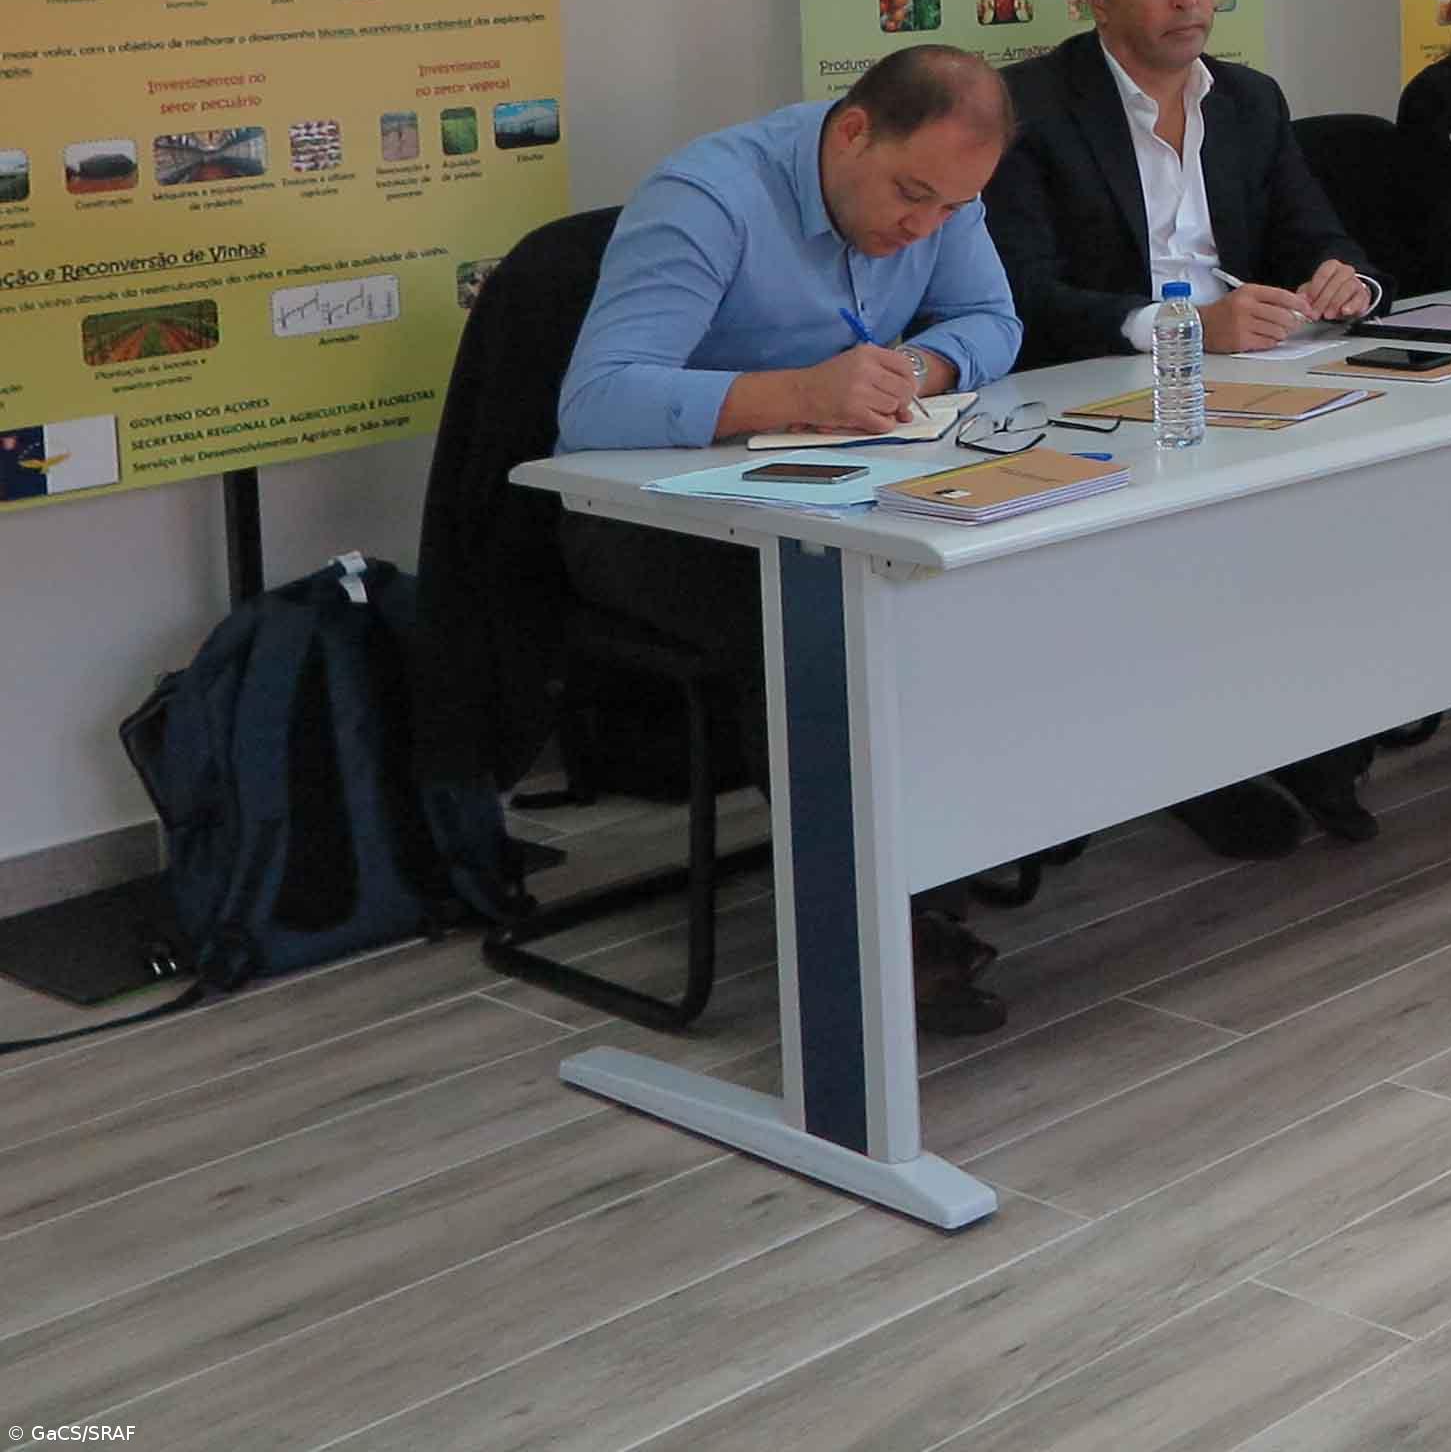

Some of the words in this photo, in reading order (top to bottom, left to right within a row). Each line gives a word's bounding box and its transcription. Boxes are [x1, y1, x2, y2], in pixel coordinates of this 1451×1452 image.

[147, 72, 244, 95] Investimentos
[249, 73, 266, 84] no
[201, 95, 262, 113] pecuário
[44, 269, 55, 281] e
[60, 250, 177, 284] Reconversão
[183, 249, 204, 265] de
[208, 242, 267, 263] Vinhas
[129, 410, 192, 430] GOVERNO
[195, 405, 220, 419] DOS
[225, 398, 271, 418] AÇORES
[131, 429, 203, 452] SECRETARIA
[206, 418, 267, 438] REGIONAL
[270, 416, 286, 428] DA
[289, 402, 367, 424] AGRICULTURA
[378, 389, 435, 409] FLORESTAS
[133, 455, 177, 473] Serviço
[180, 450, 195, 464] de
[198, 434, 298, 461] Desenvolvimento
[301, 427, 341, 445] Agrário
[344, 423, 357, 435] de
[360, 419, 379, 433] São
